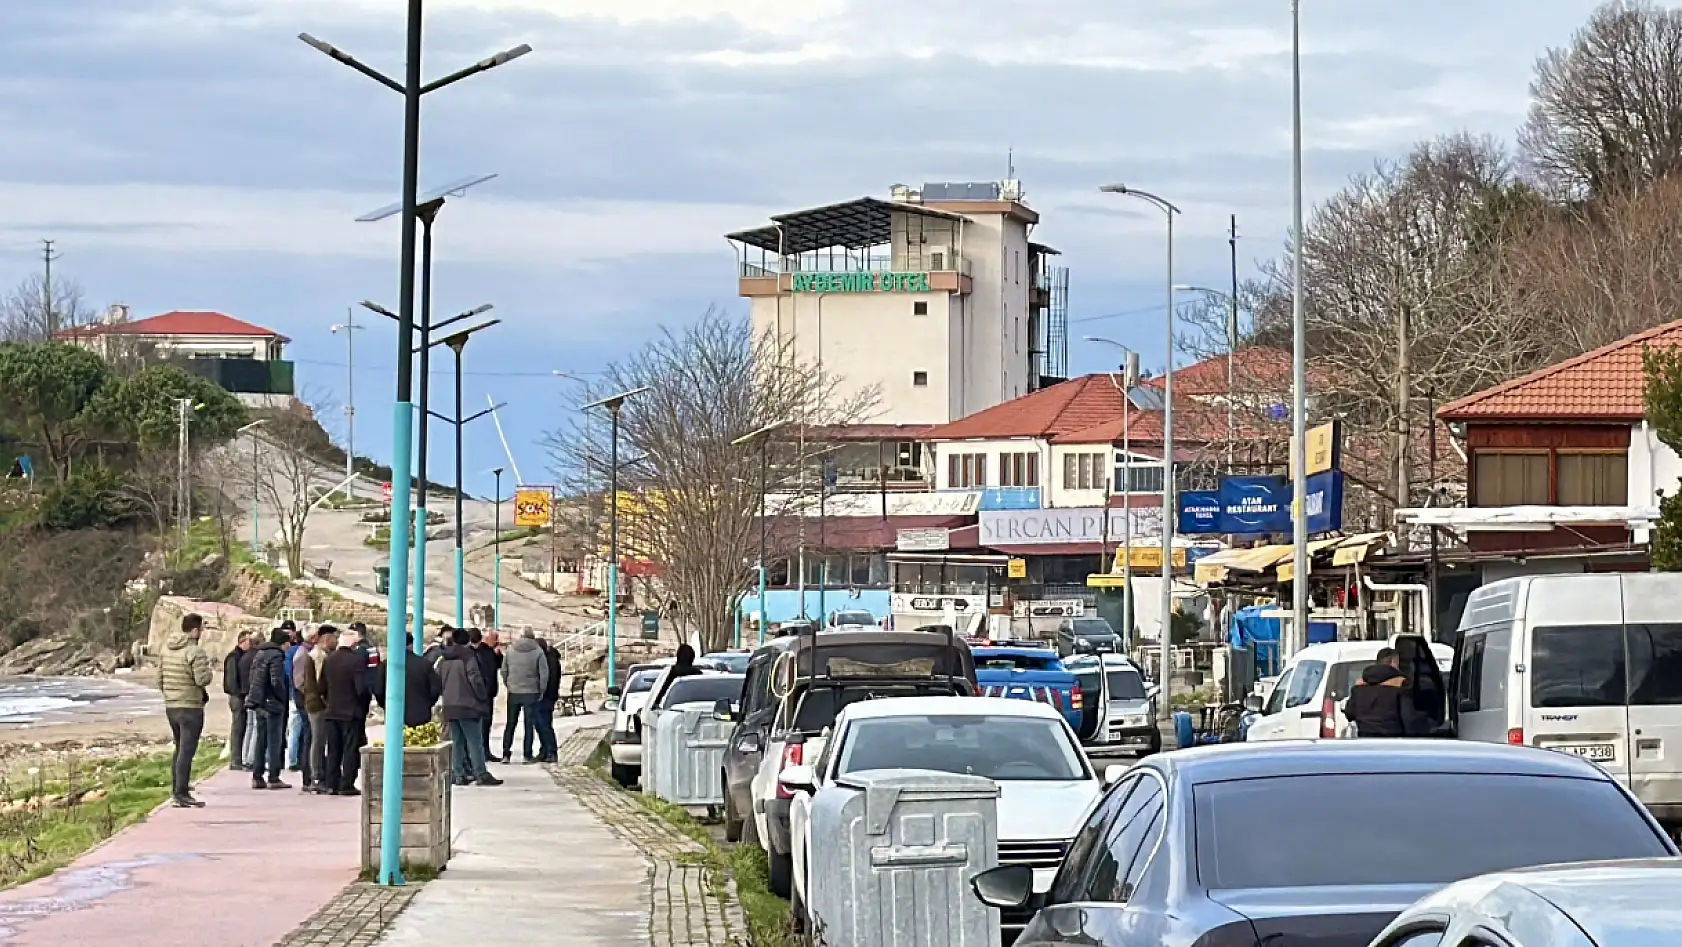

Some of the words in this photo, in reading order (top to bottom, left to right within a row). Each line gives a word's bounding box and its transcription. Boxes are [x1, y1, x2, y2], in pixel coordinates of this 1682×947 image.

[880, 272, 930, 293] OTEL
[1226, 504, 1278, 514] RESTAURANT
[982, 515, 1071, 539] SERCAN
[1541, 714, 1578, 722] TRANSIT
[1590, 747, 1611, 757] 338
